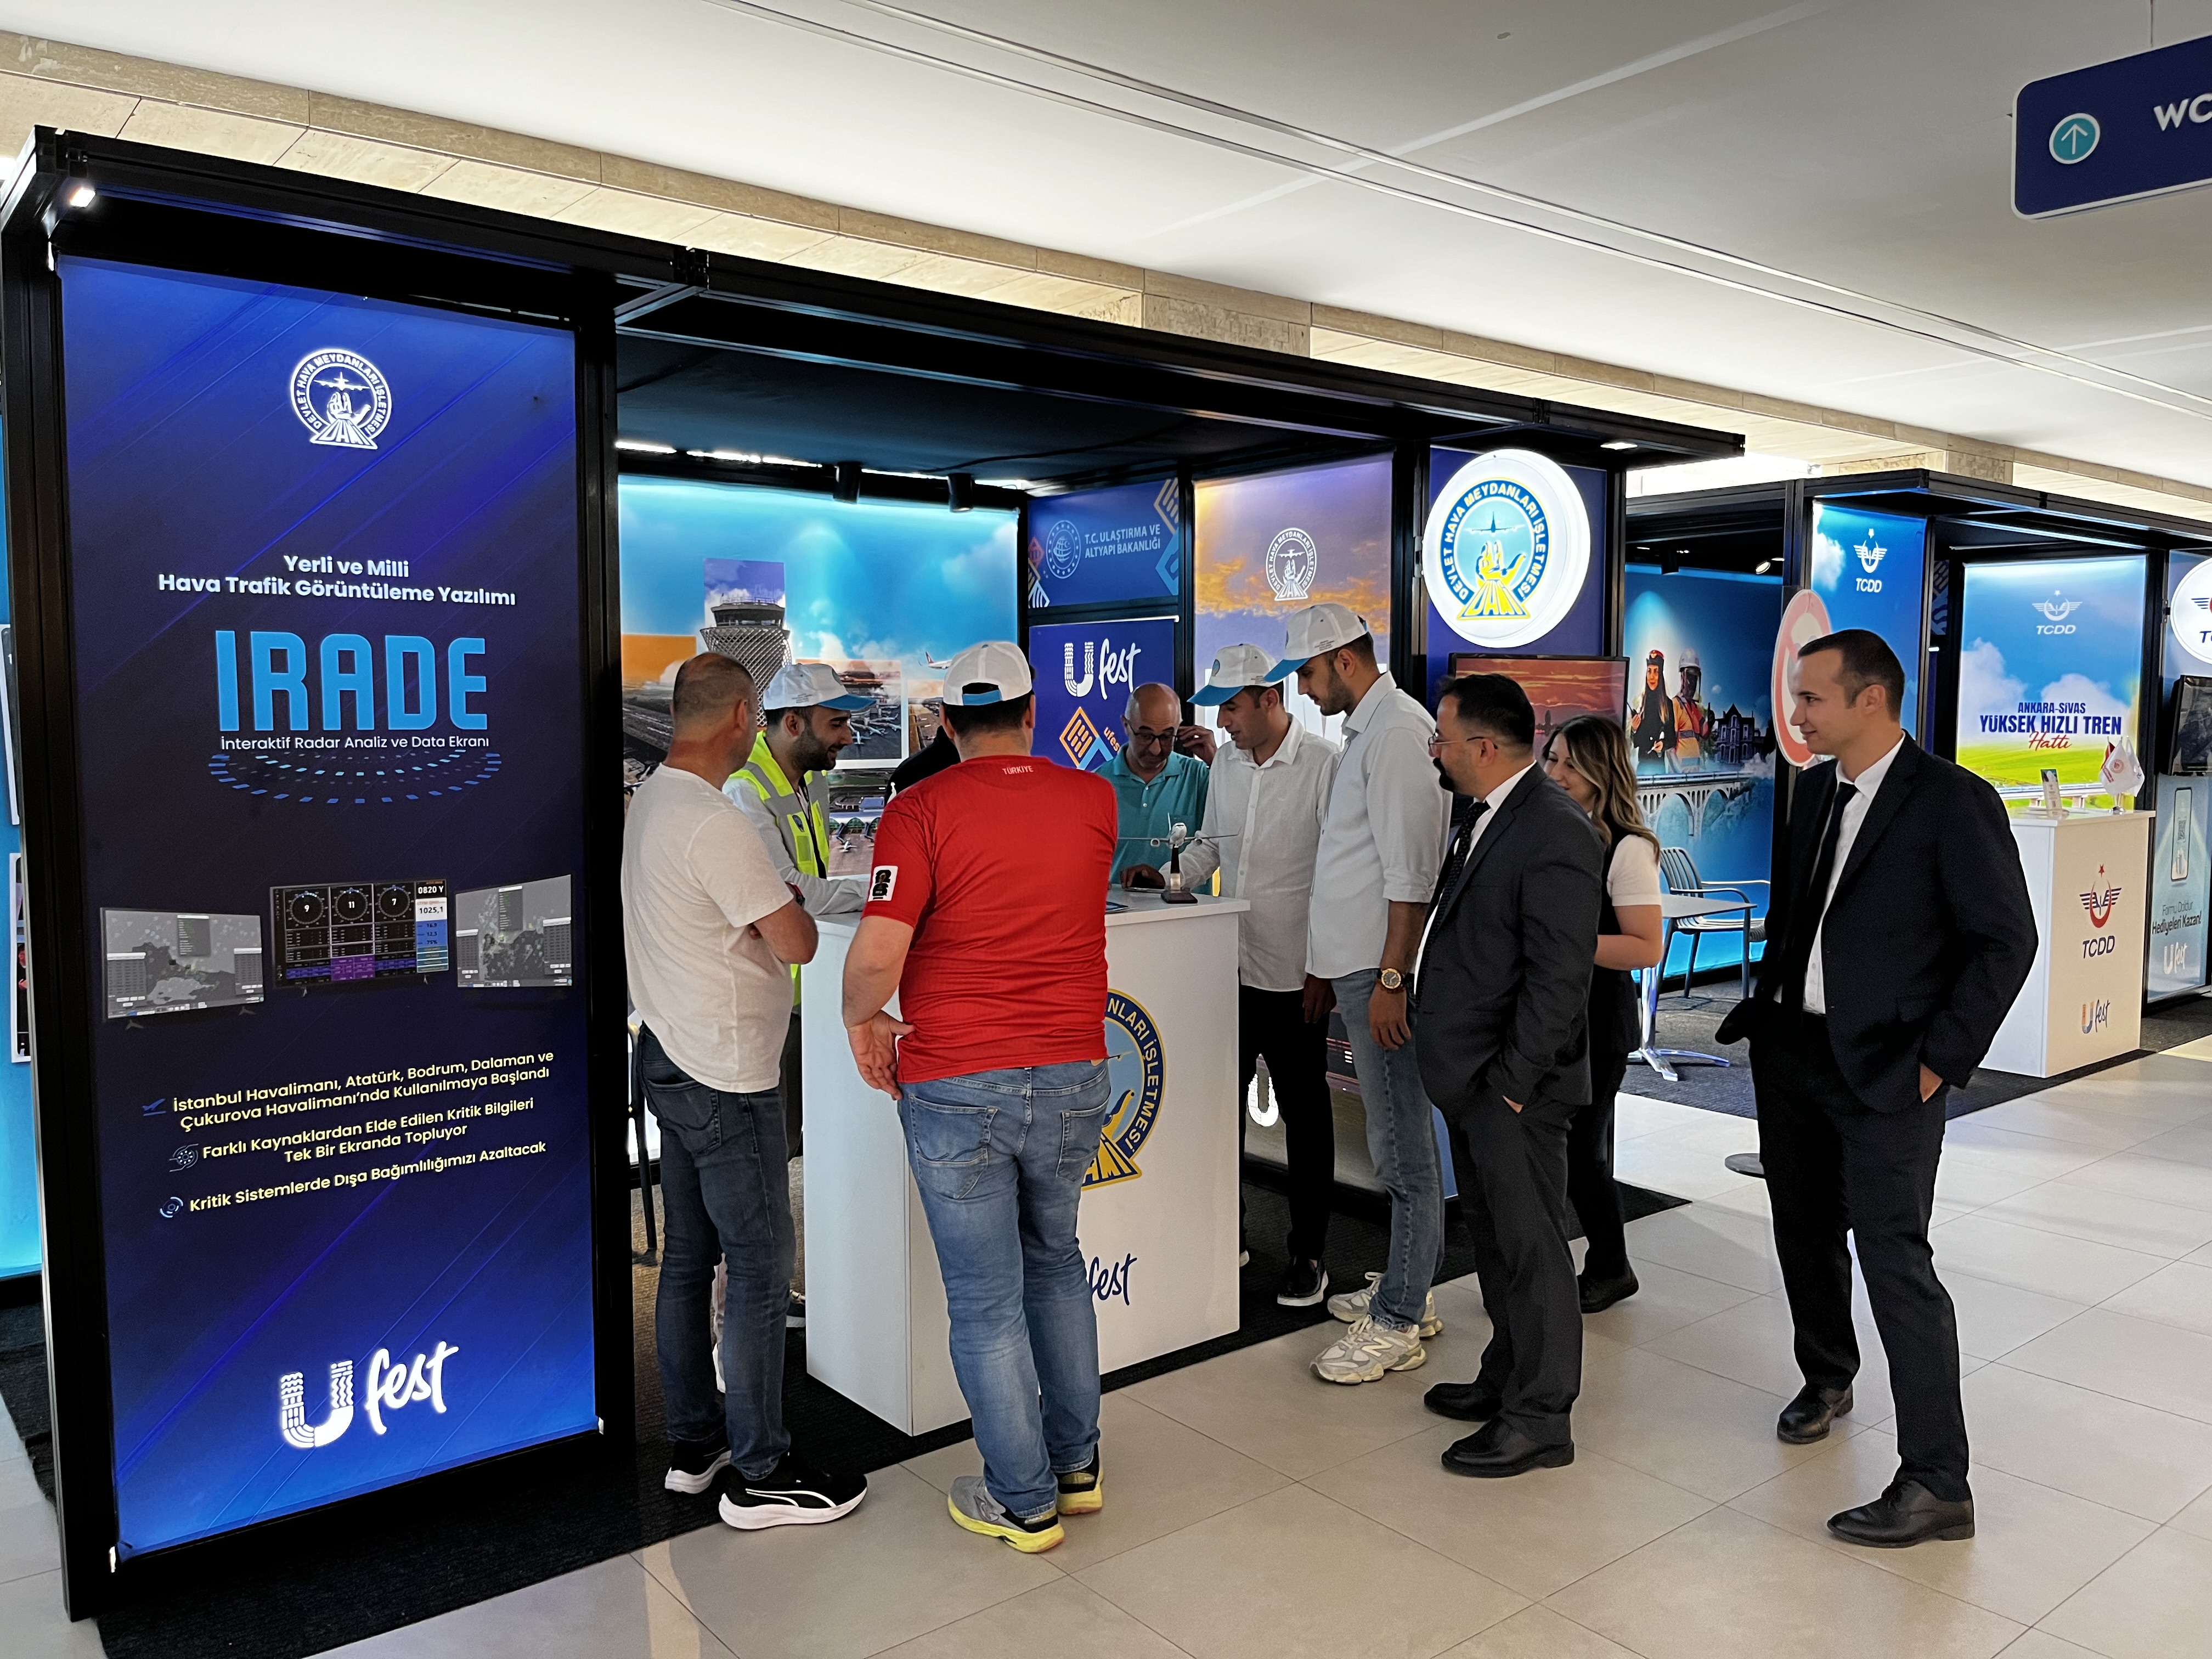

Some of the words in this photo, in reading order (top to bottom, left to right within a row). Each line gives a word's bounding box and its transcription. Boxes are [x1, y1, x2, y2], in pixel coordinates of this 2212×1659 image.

[297, 363, 317, 389] HAVA
[313, 353, 380, 385] MEYDANLARI
[296, 390, 323, 430] DEVLET
[1464, 482, 1539, 518] MEYDANLARI
[1085, 533, 1098, 544] T.C.
[1100, 527, 1147, 543] ULAŞTIRMA
[1149, 524, 1160, 535] VE
[1444, 506, 1465, 543] HAVA
[1085, 545, 1116, 558] ALTYAPI
[1117, 538, 1160, 555] BAKANLIĞI
[1269, 543, 1279, 562] HAVA
[1277, 531, 1311, 549] MEYDANLARI
[284, 555, 332, 574] Yerli
[337, 560, 363, 575] ve
[368, 560, 409, 577] Milli
[1268, 564, 1280, 590] DEVLET
[1443, 547, 1469, 601] DEVLET
[159, 574, 220, 592] Hava
[225, 577, 291, 595] Trafik
[296, 579, 435, 602] Görüntüleme
[438, 586, 516, 605] Yazılımı
[1856, 578, 1882, 593] TCDD
[2036, 625, 2076, 635] TCDD
[2199, 631, 2212, 643] T
[216, 630, 488, 731] IRADE
[2018, 702, 2086, 714] ANKARA-SİVAS
[1980, 715, 2036, 733] YÜKSEK
[2041, 715, 2078, 734] HIZLI
[2083, 716, 2122, 735] TREN
[221, 736, 291, 750] İnteraktif
[295, 737, 341, 749] Radar
[345, 736, 387, 748] Analiz
[391, 739, 408, 748] ve
[412, 736, 445, 748] Data
[449, 736, 489, 747] Ekranı
[1104, 727, 1121, 752] ufes
[2029, 731, 2072, 752] Hattı
[1002, 765, 1034, 775] TÜRKİYE
[2083, 935, 2115, 958] TCDD
[173, 1091, 242, 1111] İstanbul
[246, 1079, 342, 1102] Havalimanı,
[346, 1069, 404, 1088] Atatürk,
[408, 1063, 468, 1080] Bodrum,
[471, 1053, 534, 1071] Dalaman
[538, 1052, 554, 1062] ve
[180, 1106, 261, 1132] Çukurova
[394, 1076, 487, 1098] Kullanılmaya
[491, 1067, 549, 1085] Başlandı
[1125, 1039, 1159, 1152] İŞLETMESİ
[203, 1141, 246, 1159] Farklı
[251, 1125, 362, 1151] Kaynaklardan
[366, 1118, 397, 1133] Elde
[401, 1112, 443, 1128] Edilen
[448, 1105, 482, 1120] Kritik
[485, 1097, 534, 1116] Bilgileri
[284, 1146, 312, 1163] Tek
[315, 1144, 335, 1159] Bir
[339, 1133, 401, 1154] Ekranda
[405, 1124, 467, 1144] Topluyor
[190, 1193, 231, 1212] Kritik
[235, 1177, 330, 1204] Sistemlerde
[335, 1171, 368, 1187] Dışa
[371, 1154, 476, 1180] Bağımlılığımızı
[479, 1141, 546, 1162] Azaltacak
[1089, 1253, 1137, 1306] fest
